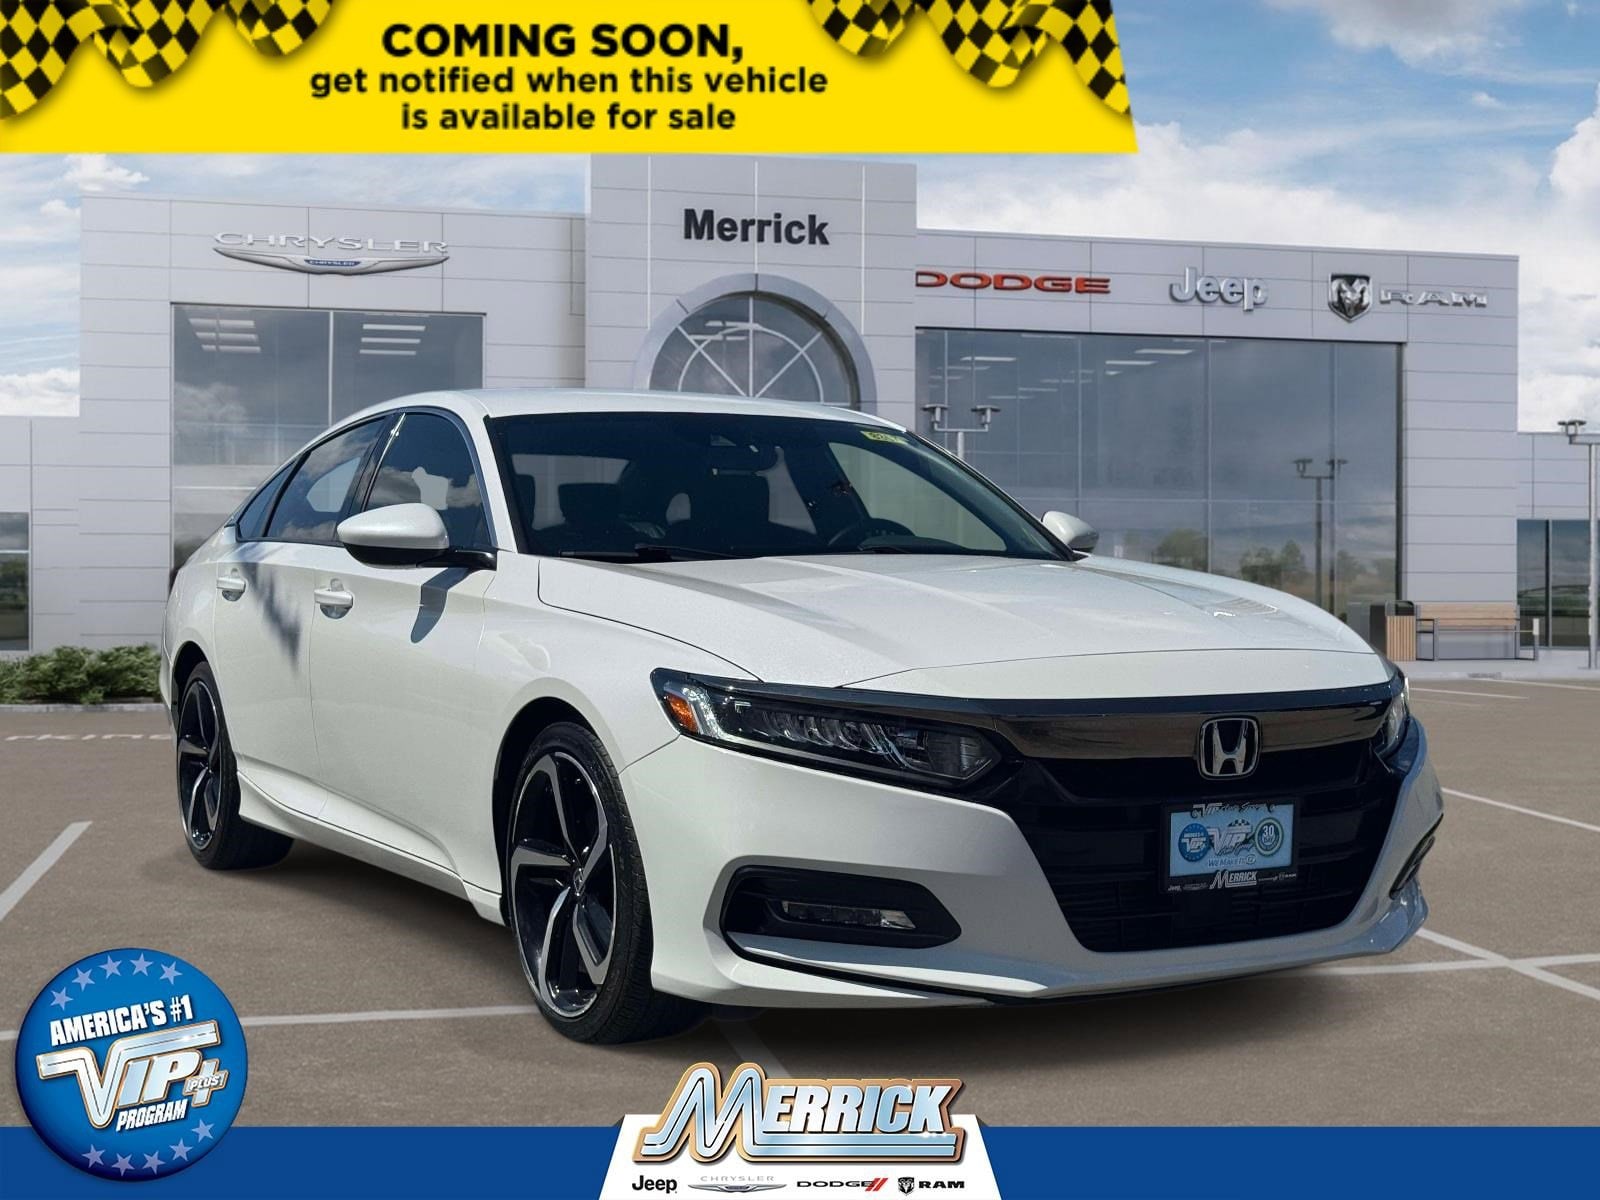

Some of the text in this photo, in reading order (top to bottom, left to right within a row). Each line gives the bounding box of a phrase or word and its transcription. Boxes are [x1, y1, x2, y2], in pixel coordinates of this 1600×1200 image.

[683, 208, 830, 246] Merrick
[214, 231, 450, 254] CHRYSLER
[915, 270, 1111, 294] DODGE
[1169, 266, 1269, 311] Jeep
[1379, 289, 1488, 308] RAM
[1262, 825, 1275, 837] 30
[1209, 870, 1257, 890] MERRICK
